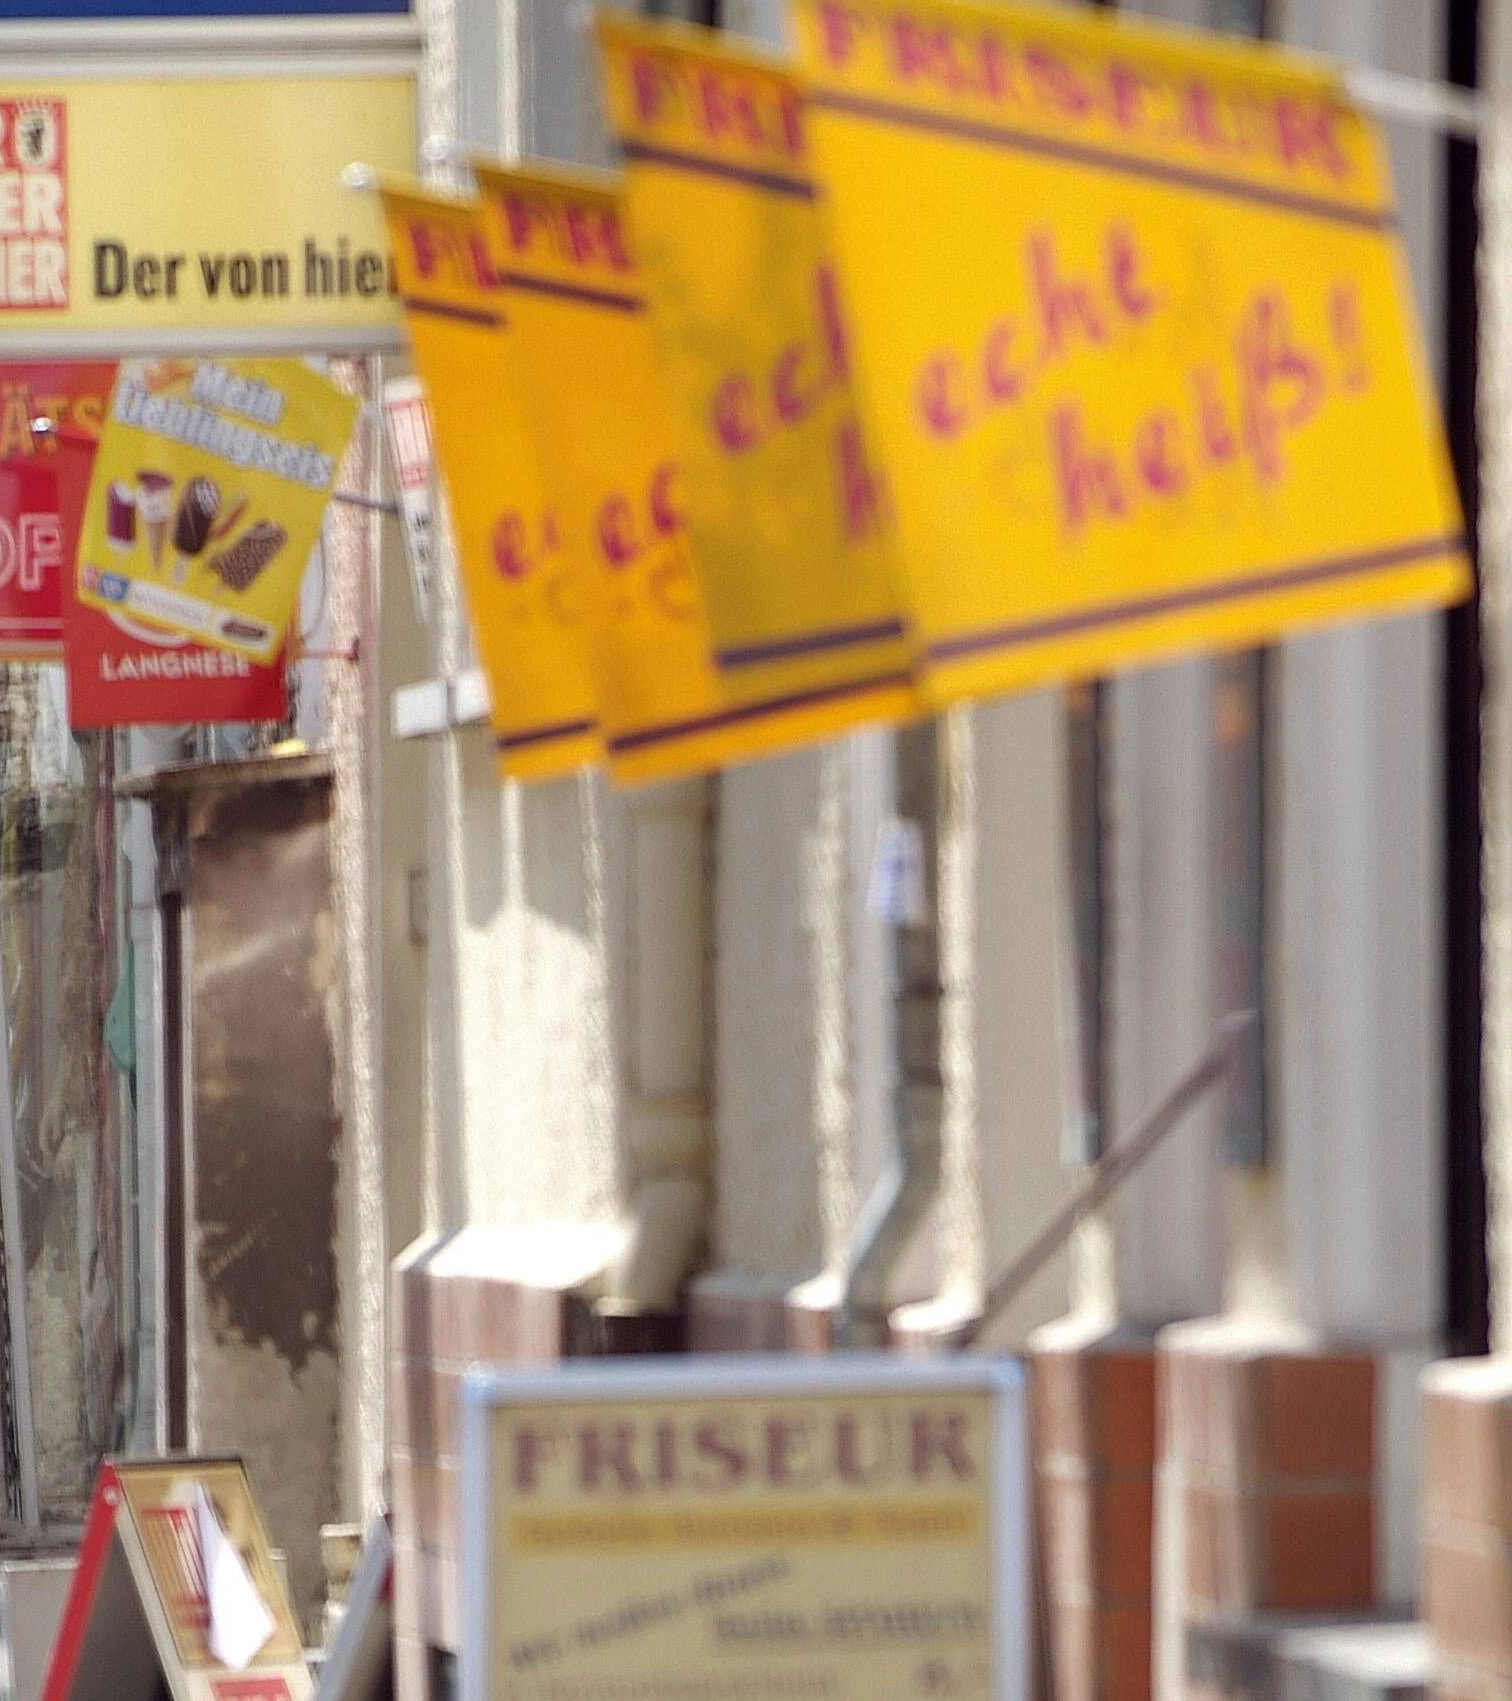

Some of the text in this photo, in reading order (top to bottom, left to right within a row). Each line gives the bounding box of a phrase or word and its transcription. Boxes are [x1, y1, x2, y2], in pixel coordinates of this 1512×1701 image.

[93, 238, 187, 300] Der
[200, 253, 289, 298] von
[101, 651, 251, 682] LANGNESE
[513, 1411, 976, 1492] FRISEUR
